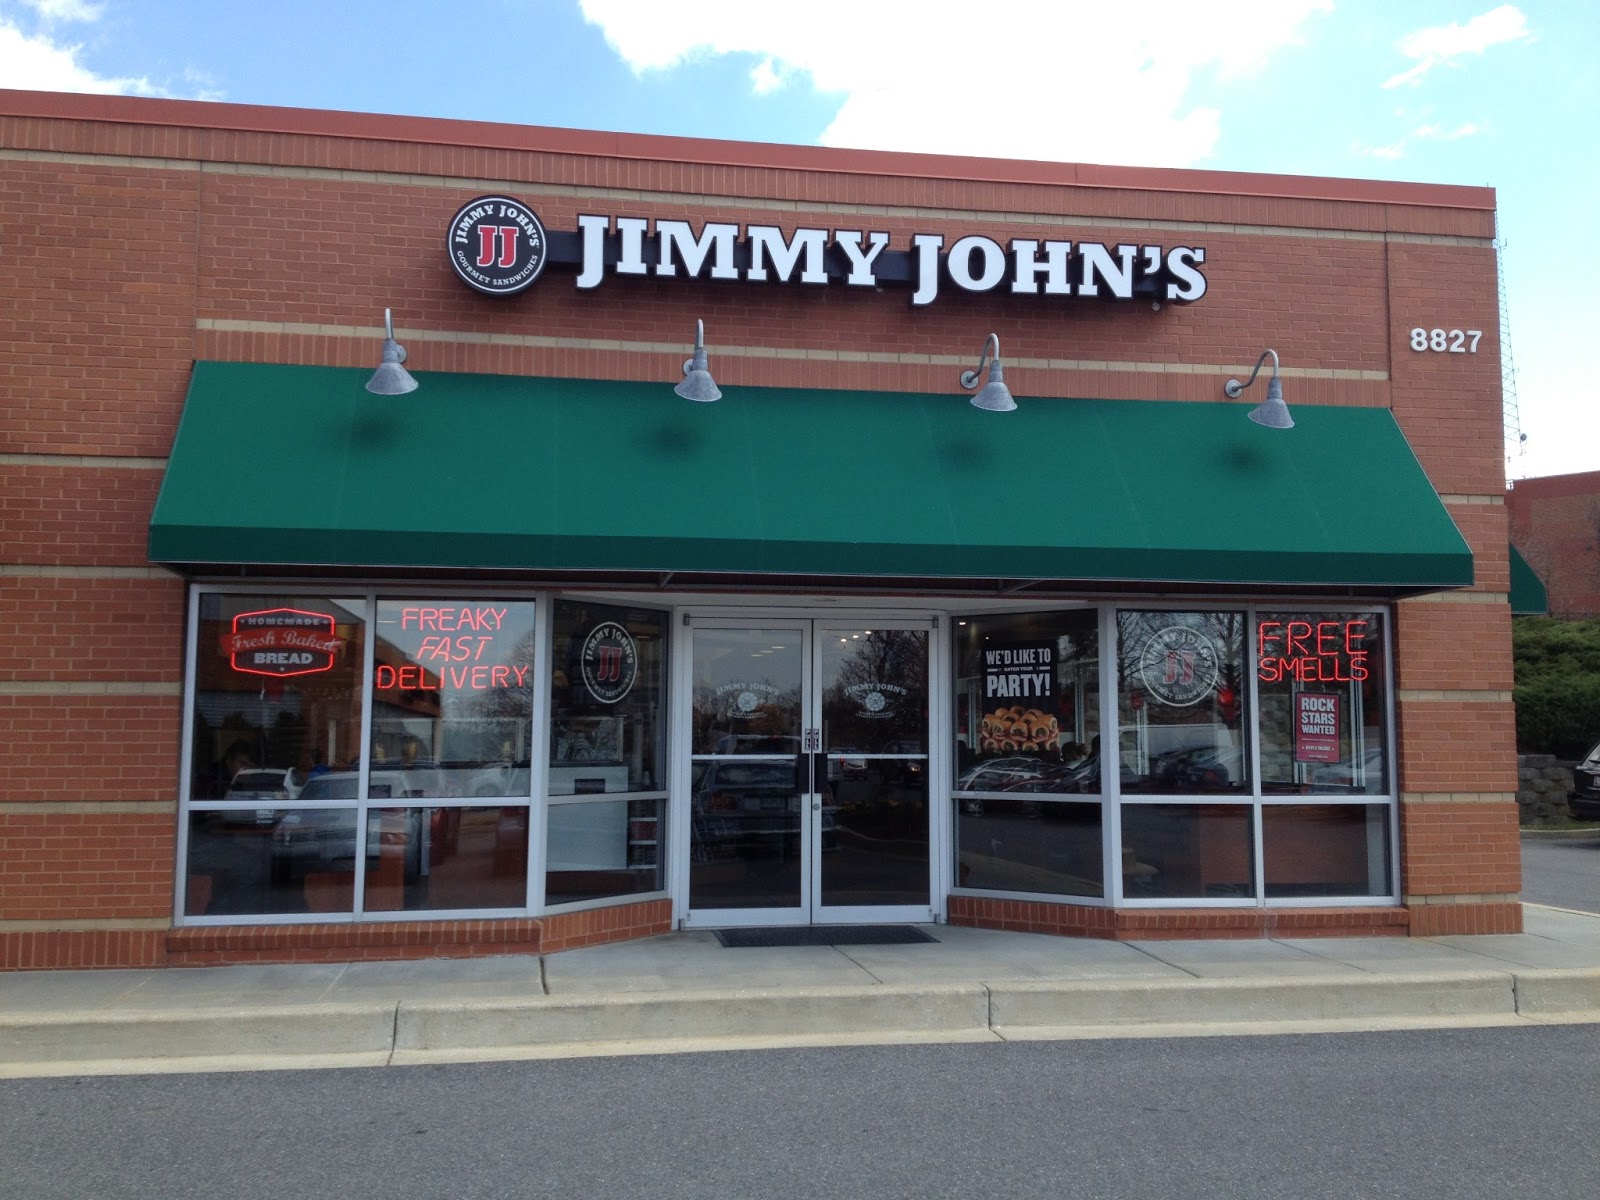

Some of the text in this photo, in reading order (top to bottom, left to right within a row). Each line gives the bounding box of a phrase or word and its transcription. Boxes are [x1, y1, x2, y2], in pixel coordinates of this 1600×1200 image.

[455, 204, 539, 248] JIMMY JOHN'S
[476, 225, 519, 268] JJ
[457, 250, 538, 285] GOURMET SANDWICHES
[576, 213, 1208, 305] JIMMY JOHN'S
[1410, 327, 1482, 353] 8827
[248, 618, 320, 626] HOMEMADE
[402, 607, 507, 631] FREAKY
[232, 629, 342, 652] Fresh Baked
[416, 636, 493, 661] FAST
[585, 628, 634, 664] JIMMY JOHN'S
[1259, 621, 1368, 656] FREE
[254, 652, 313, 664] BREAD
[597, 645, 623, 682] JJ
[986, 647, 1051, 665] WE'D LIKE TO
[376, 665, 528, 689] DELIVERY
[1259, 657, 1369, 681] SMELLS
[844, 683, 907, 697] JIMMY JOHN'S
[987, 673, 1051, 697] PARTY!
[1301, 697, 1335, 711] ROCK
[1301, 712, 1335, 725] STARS
[1301, 725, 1335, 735] WANTED
